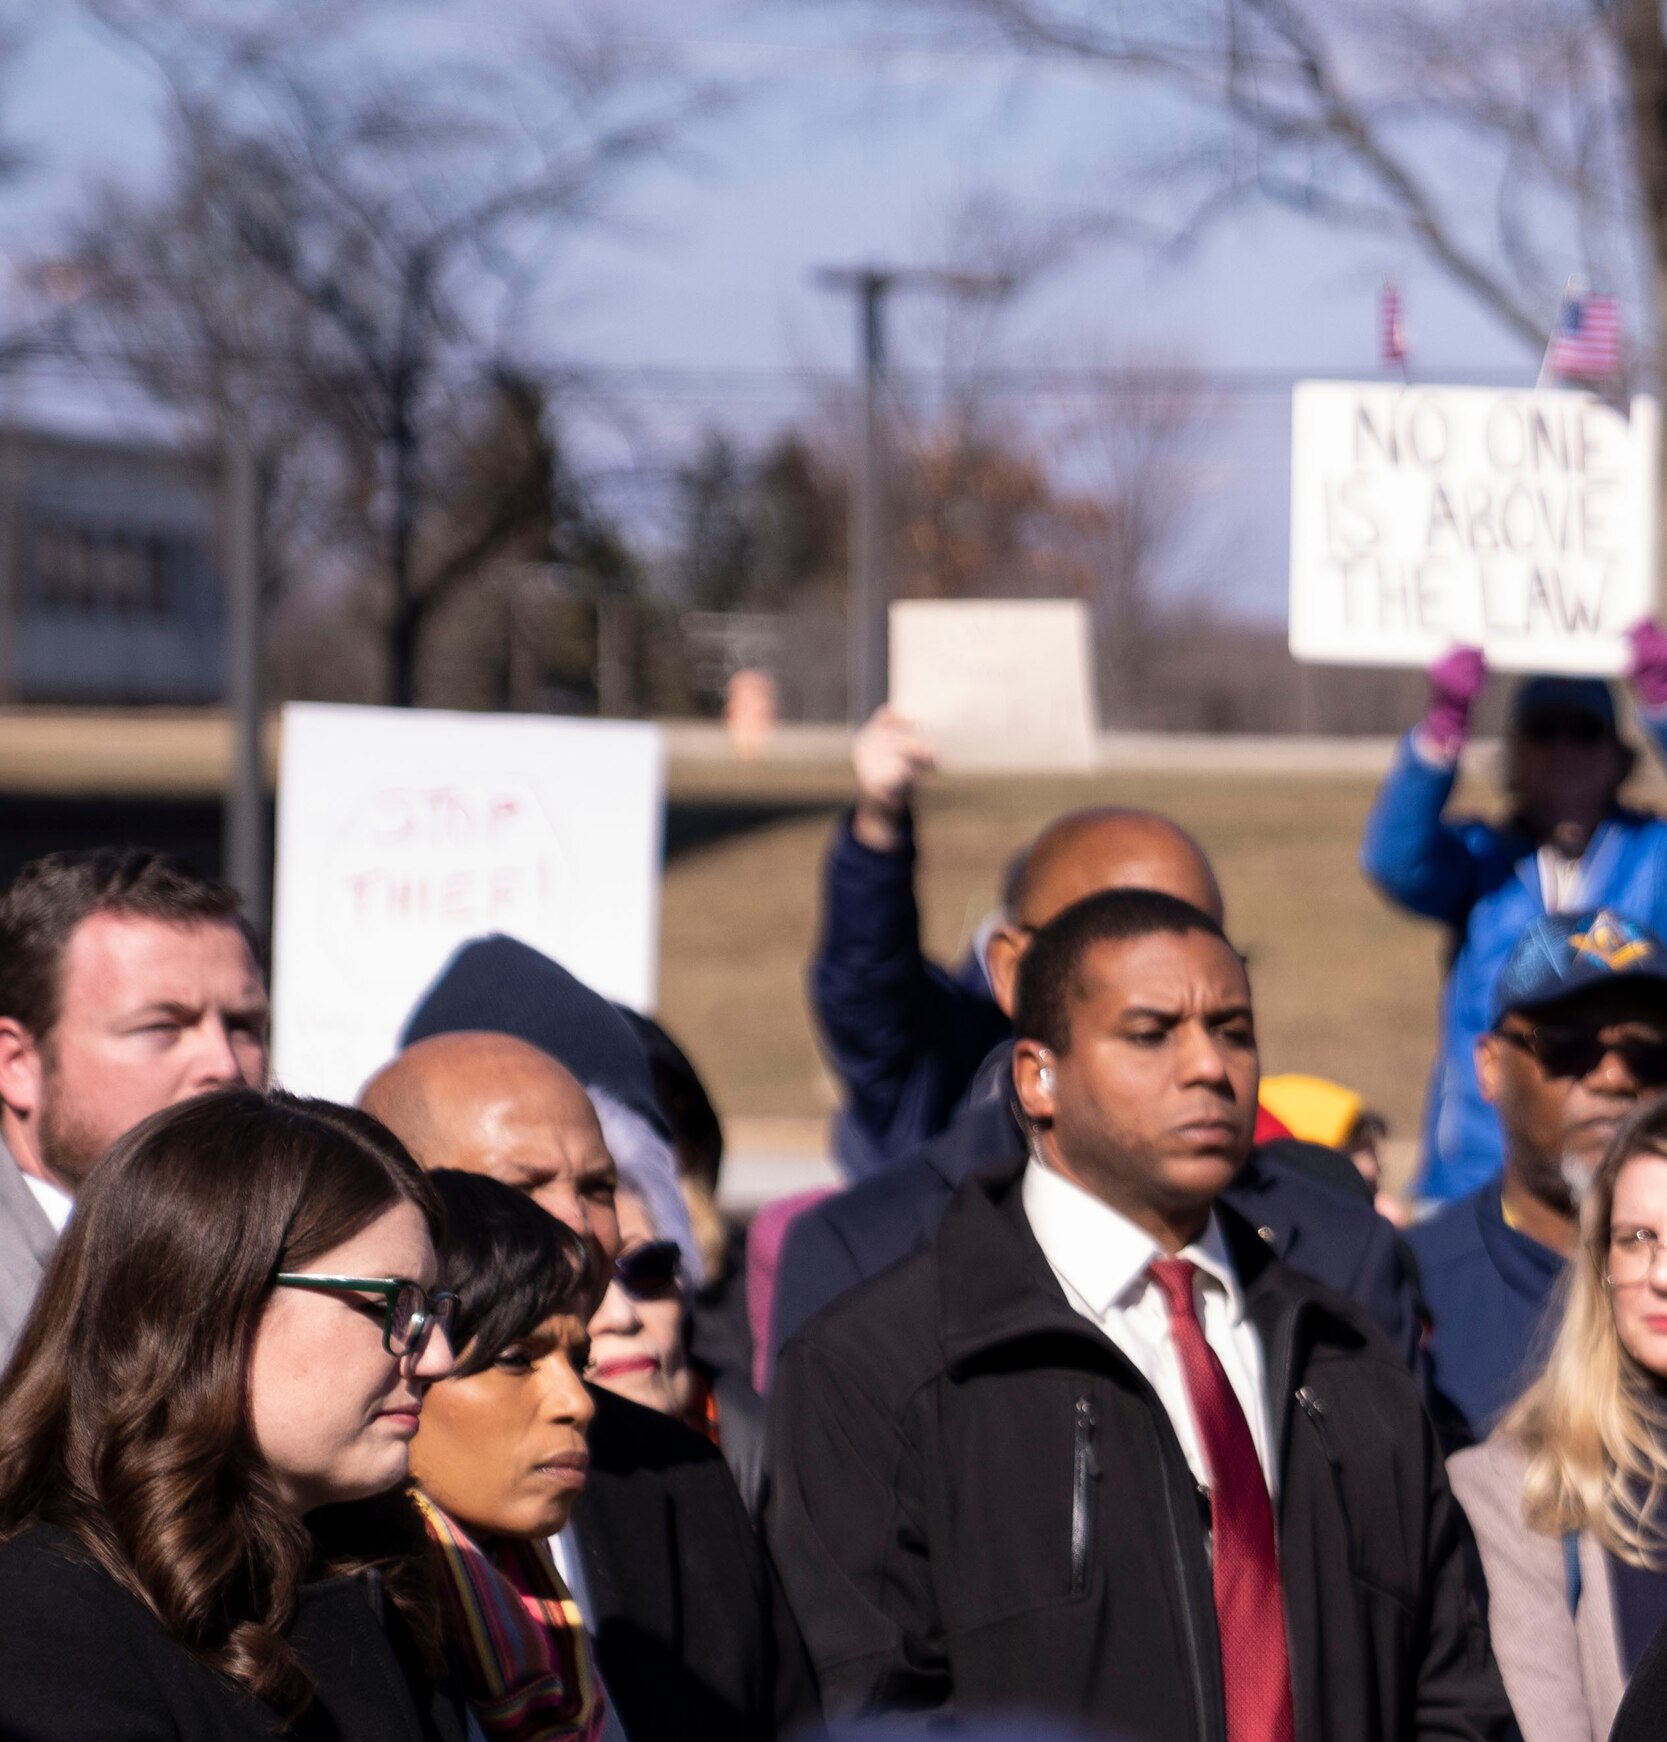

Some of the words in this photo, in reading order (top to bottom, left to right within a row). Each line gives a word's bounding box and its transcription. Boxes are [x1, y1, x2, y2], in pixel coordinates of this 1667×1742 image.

[1352, 398, 1449, 468] NO
[1485, 396, 1608, 478] ONE
[1323, 474, 1381, 550] IS
[1427, 474, 1618, 558] ABOVE
[1328, 553, 1447, 634] THE
[1475, 560, 1614, 636] LAW
[373, 784, 528, 850] STOP
